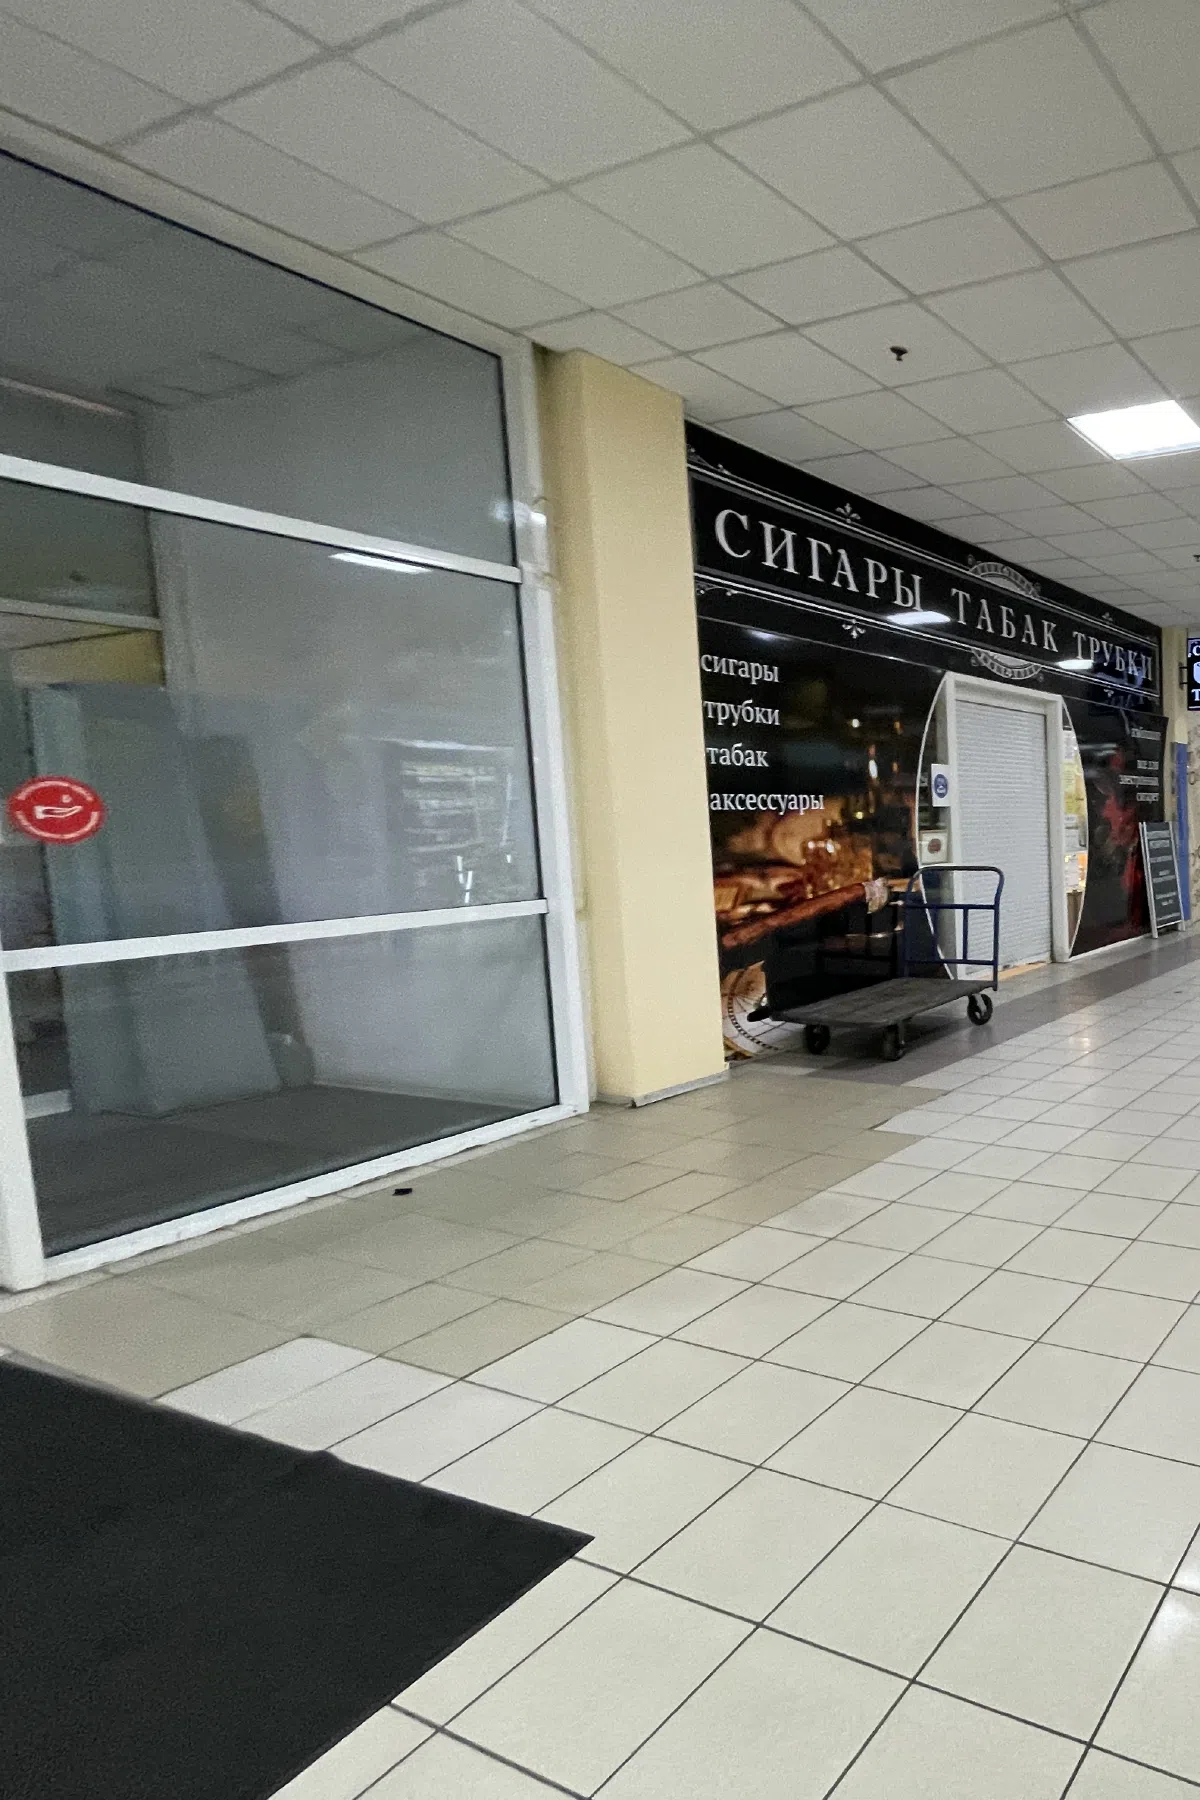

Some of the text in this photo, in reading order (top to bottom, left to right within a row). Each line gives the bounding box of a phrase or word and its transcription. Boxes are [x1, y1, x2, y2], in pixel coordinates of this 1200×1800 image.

[714, 508, 1153, 681] СИГАРЫ ТАБАК ТРУБКИ
[700, 654, 780, 685] сигары
[703, 699, 780, 727] трубки
[705, 742, 769, 767] табак
[709, 792, 825, 815] аксессуары
